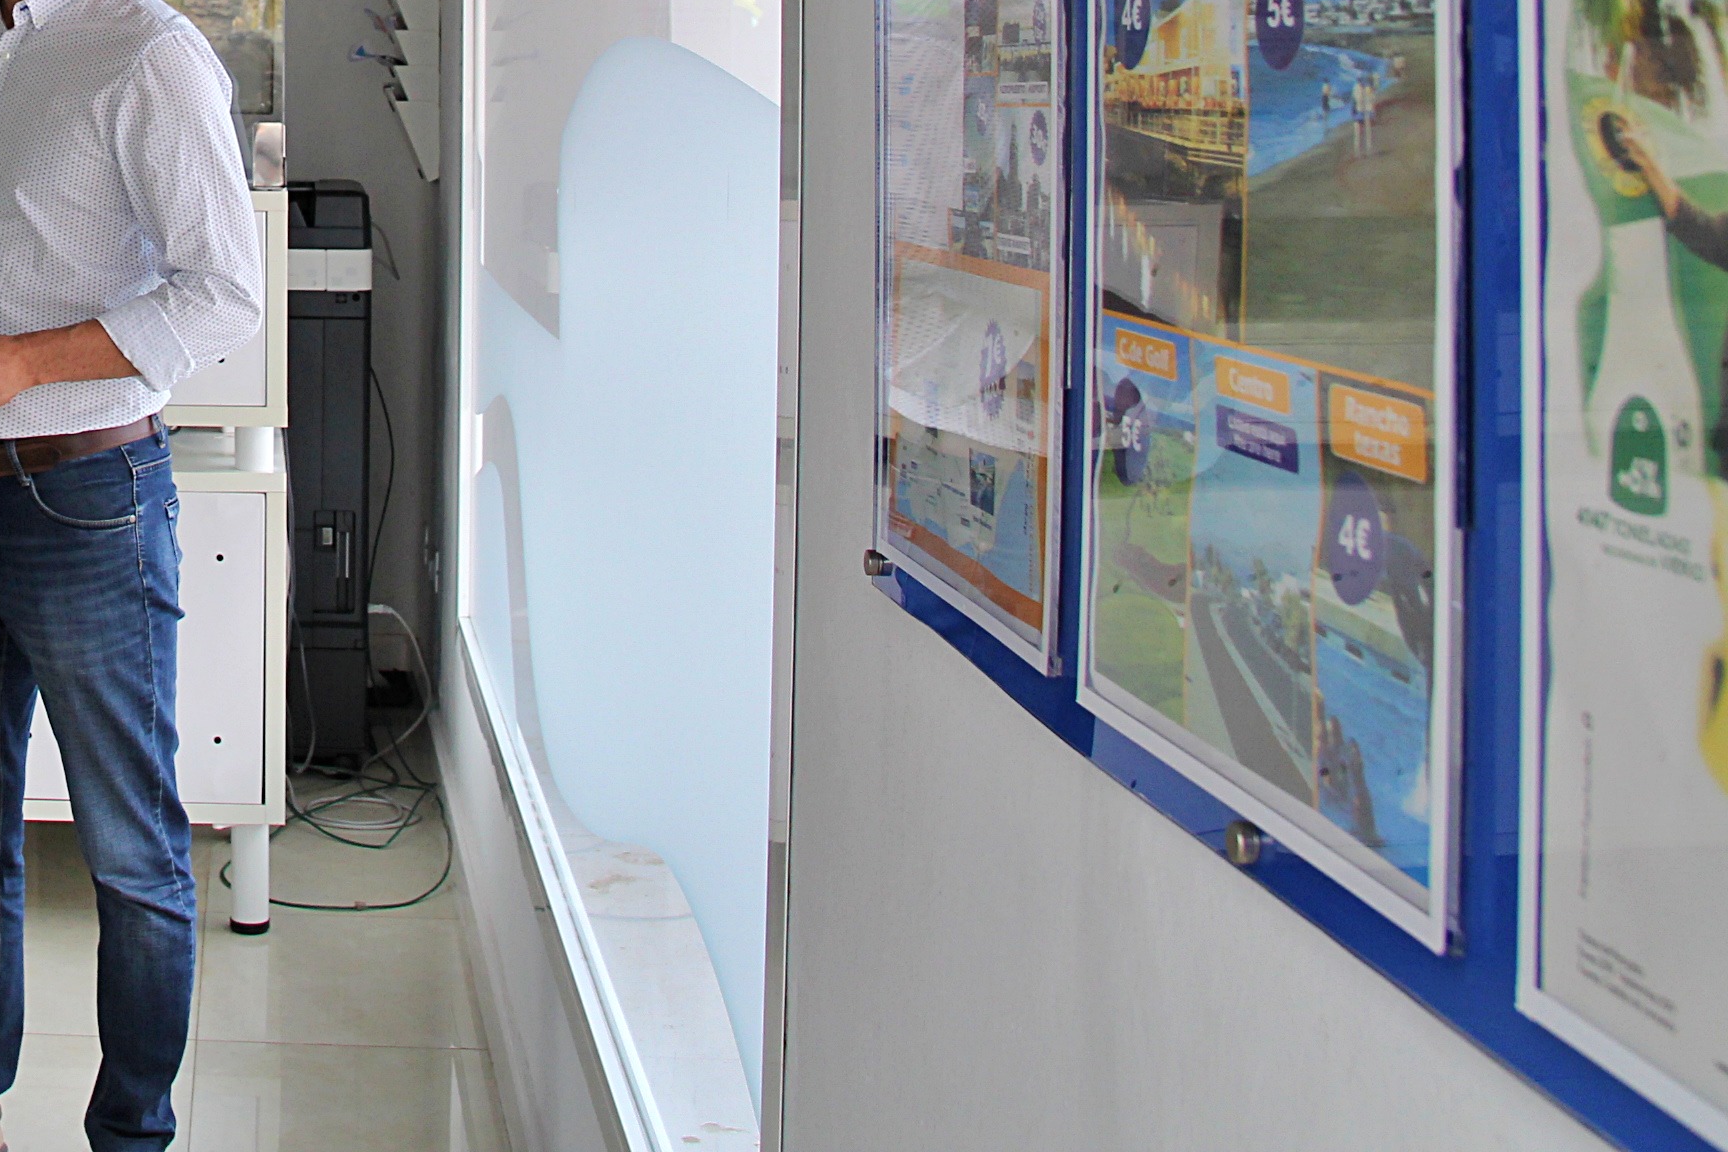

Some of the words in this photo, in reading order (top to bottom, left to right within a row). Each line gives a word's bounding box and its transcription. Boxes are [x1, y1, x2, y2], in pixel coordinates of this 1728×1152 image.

[1145, 344, 1170, 371] Golf
[1228, 367, 1272, 402] Centro
[1121, 415, 1142, 452] 5€
[1344, 395, 1411, 438] Rancho
[1353, 430, 1402, 467] texas
[1337, 513, 1372, 561] 4€
